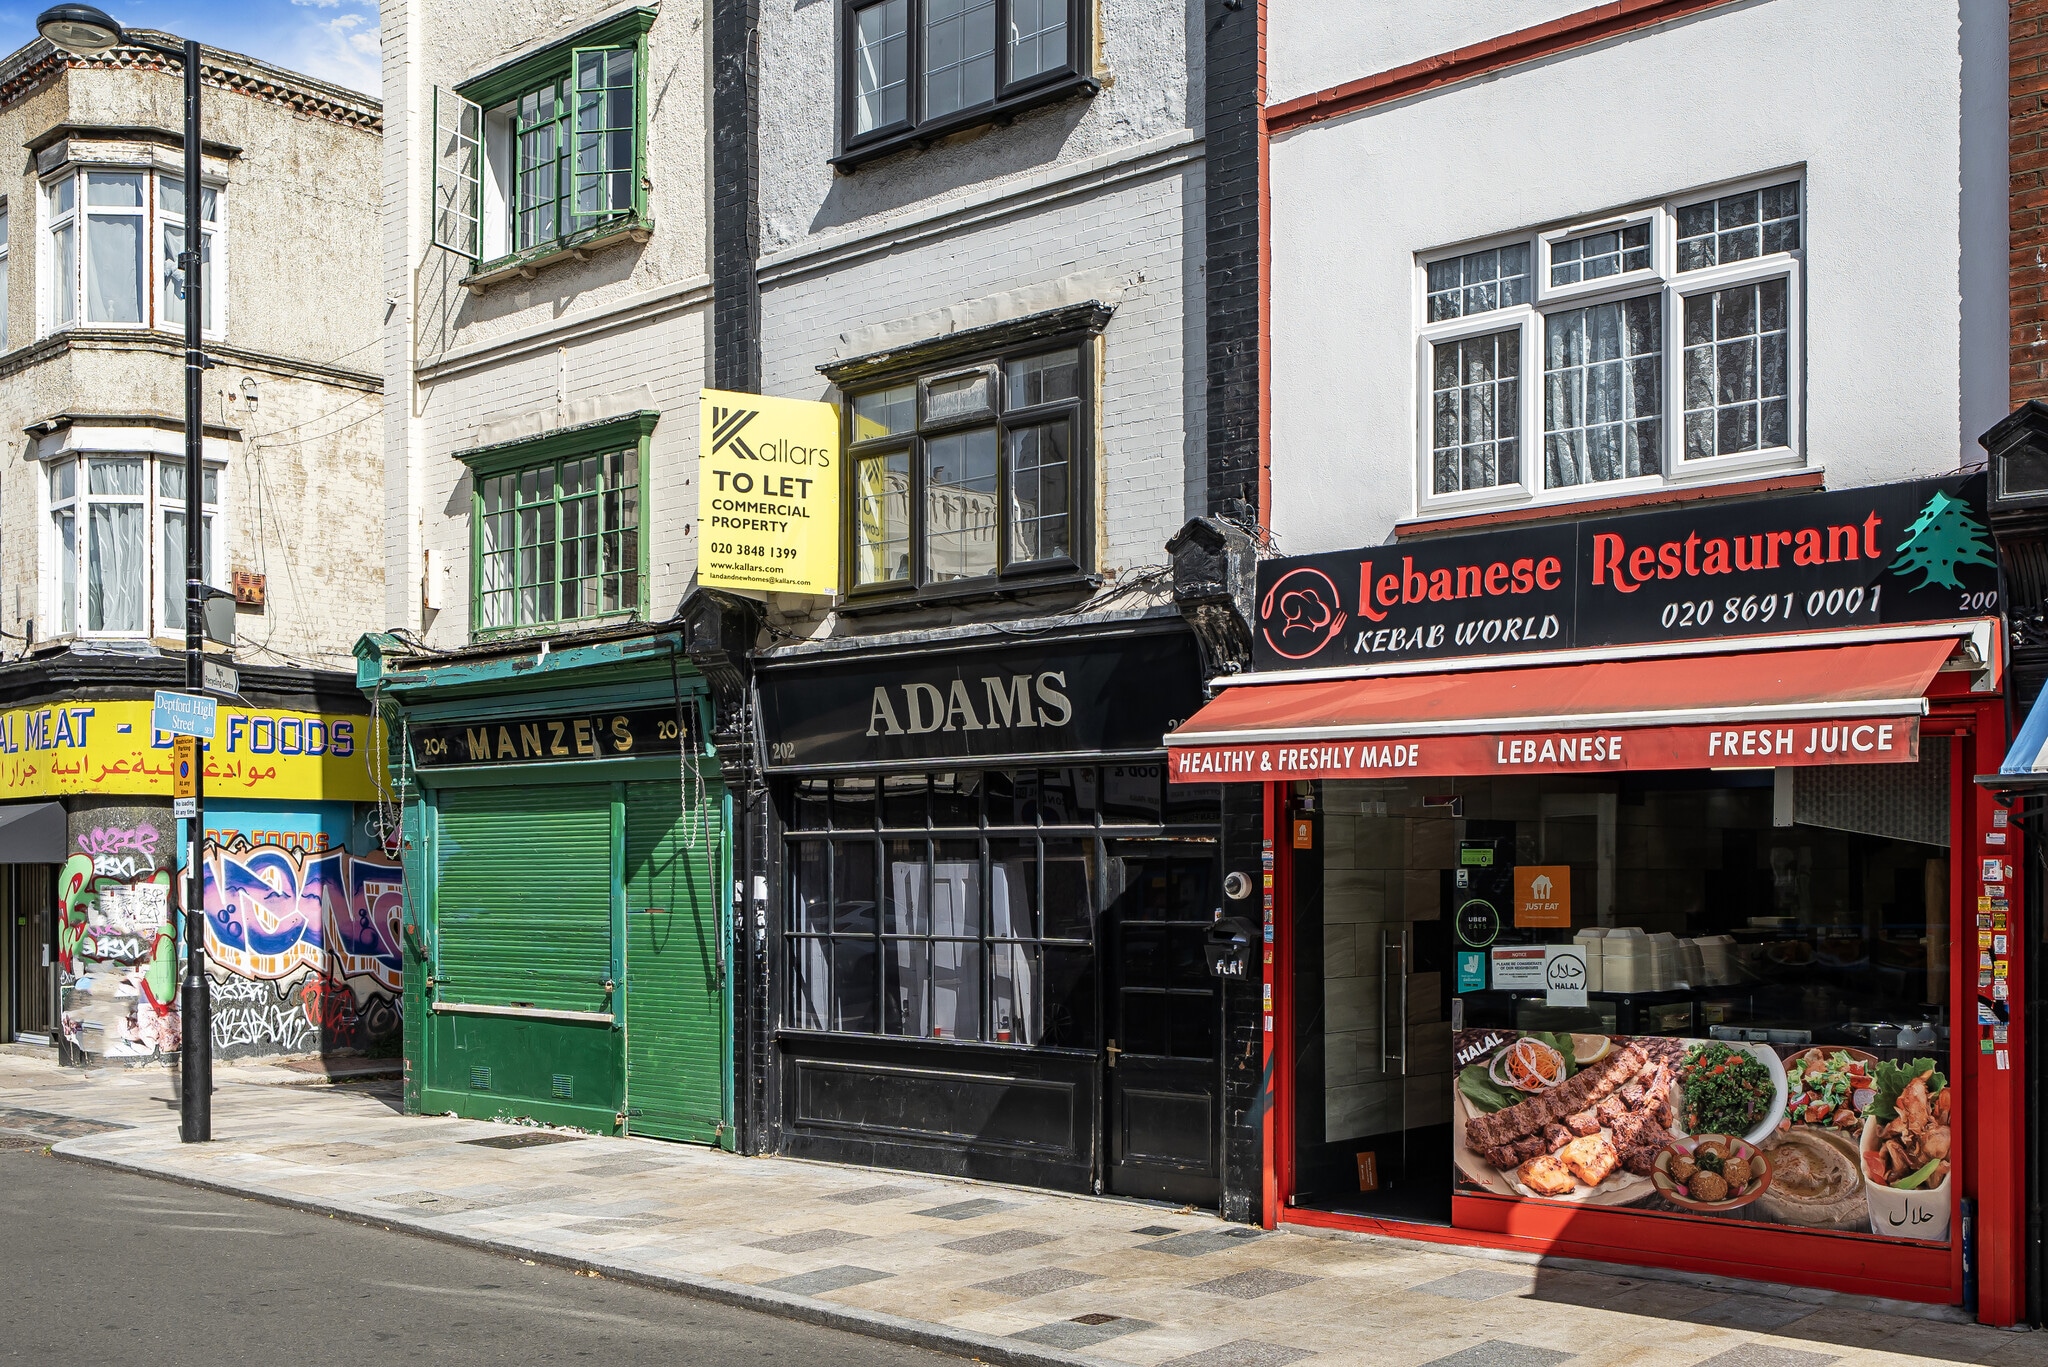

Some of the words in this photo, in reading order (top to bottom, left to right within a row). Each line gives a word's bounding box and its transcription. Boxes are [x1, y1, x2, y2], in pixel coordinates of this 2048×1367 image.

[712, 406, 829, 468] Kallars
[713, 470, 754, 493] TO
[764, 475, 813, 499] LET
[712, 499, 810, 518] COMMERCIAL
[712, 516, 788, 533] PROPERTY
[711, 542, 733, 554] 020
[736, 544, 765, 557] 3848
[770, 547, 797, 559] 1399
[710, 562, 784, 574] www.kallars.com
[1357, 555, 1562, 622] Lebanese
[1591, 509, 1882, 593] Restaurant
[709, 573, 811, 586] landandnewhomes@kallars.com
[1661, 600, 1714, 629] 020
[1722, 592, 1794, 624] 8691
[1807, 584, 1882, 617] 0001
[1959, 590, 1998, 612] 200
[1354, 625, 1445, 654] KEBAB
[1454, 614, 1560, 646] WORLD
[157, 695, 191, 714] Deptford
[193, 700, 214, 720] High
[866, 671, 1073, 737] ADAMS
[25, 708, 96, 751] MEAT
[226, 714, 355, 758] FOODS
[172, 714, 195, 732] Street
[424, 737, 448, 756] 204
[466, 715, 634, 761] MANZE'S
[1497, 736, 1623, 764] LEBANESE
[1708, 729, 1794, 757] FRESH
[1804, 724, 1893, 754] JUICE
[772, 742, 796, 760] 202
[1179, 750, 1255, 773] HEALTHY
[1260, 750, 1272, 772] &
[1278, 746, 1355, 770] FRESHLY
[1360, 744, 1419, 768] MADE
[251, 830, 330, 852] FOODS
[1525, 902, 1543, 911] JUST
[1544, 902, 1559, 910] EAT
[1555, 982, 1579, 990] HALAL
[1456, 1032, 1503, 1066] HALAL
